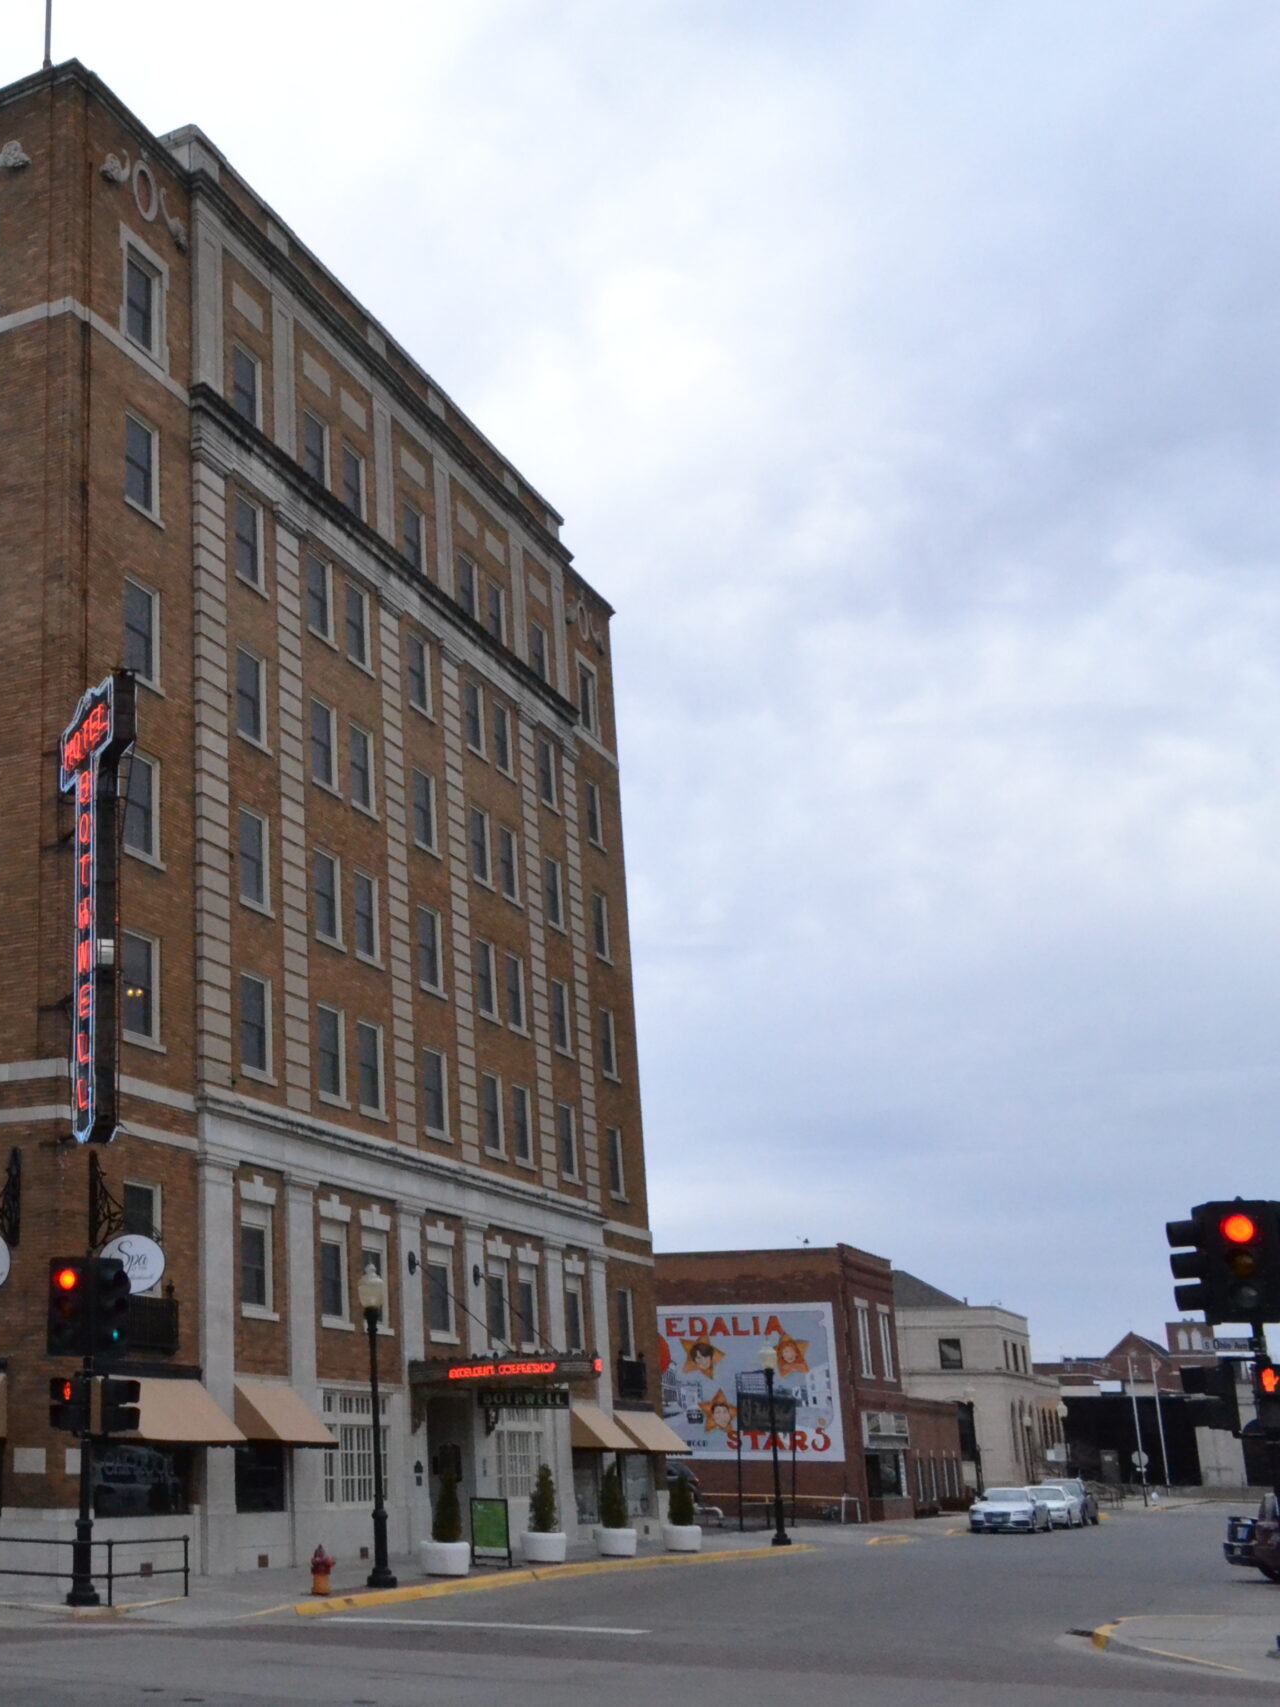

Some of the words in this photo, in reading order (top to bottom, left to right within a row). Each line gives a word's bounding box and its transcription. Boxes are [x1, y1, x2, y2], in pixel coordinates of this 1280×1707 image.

[64, 703, 108, 771] HOTEL
[78, 771, 94, 1109] BOTHWELL
[111, 1240, 148, 1274] Spa
[665, 1315, 785, 1337] EDALIA
[1213, 1339, 1231, 1350] Ohio
[483, 1391, 564, 1405] BOTHWELL
[726, 1427, 832, 1452] STARS
